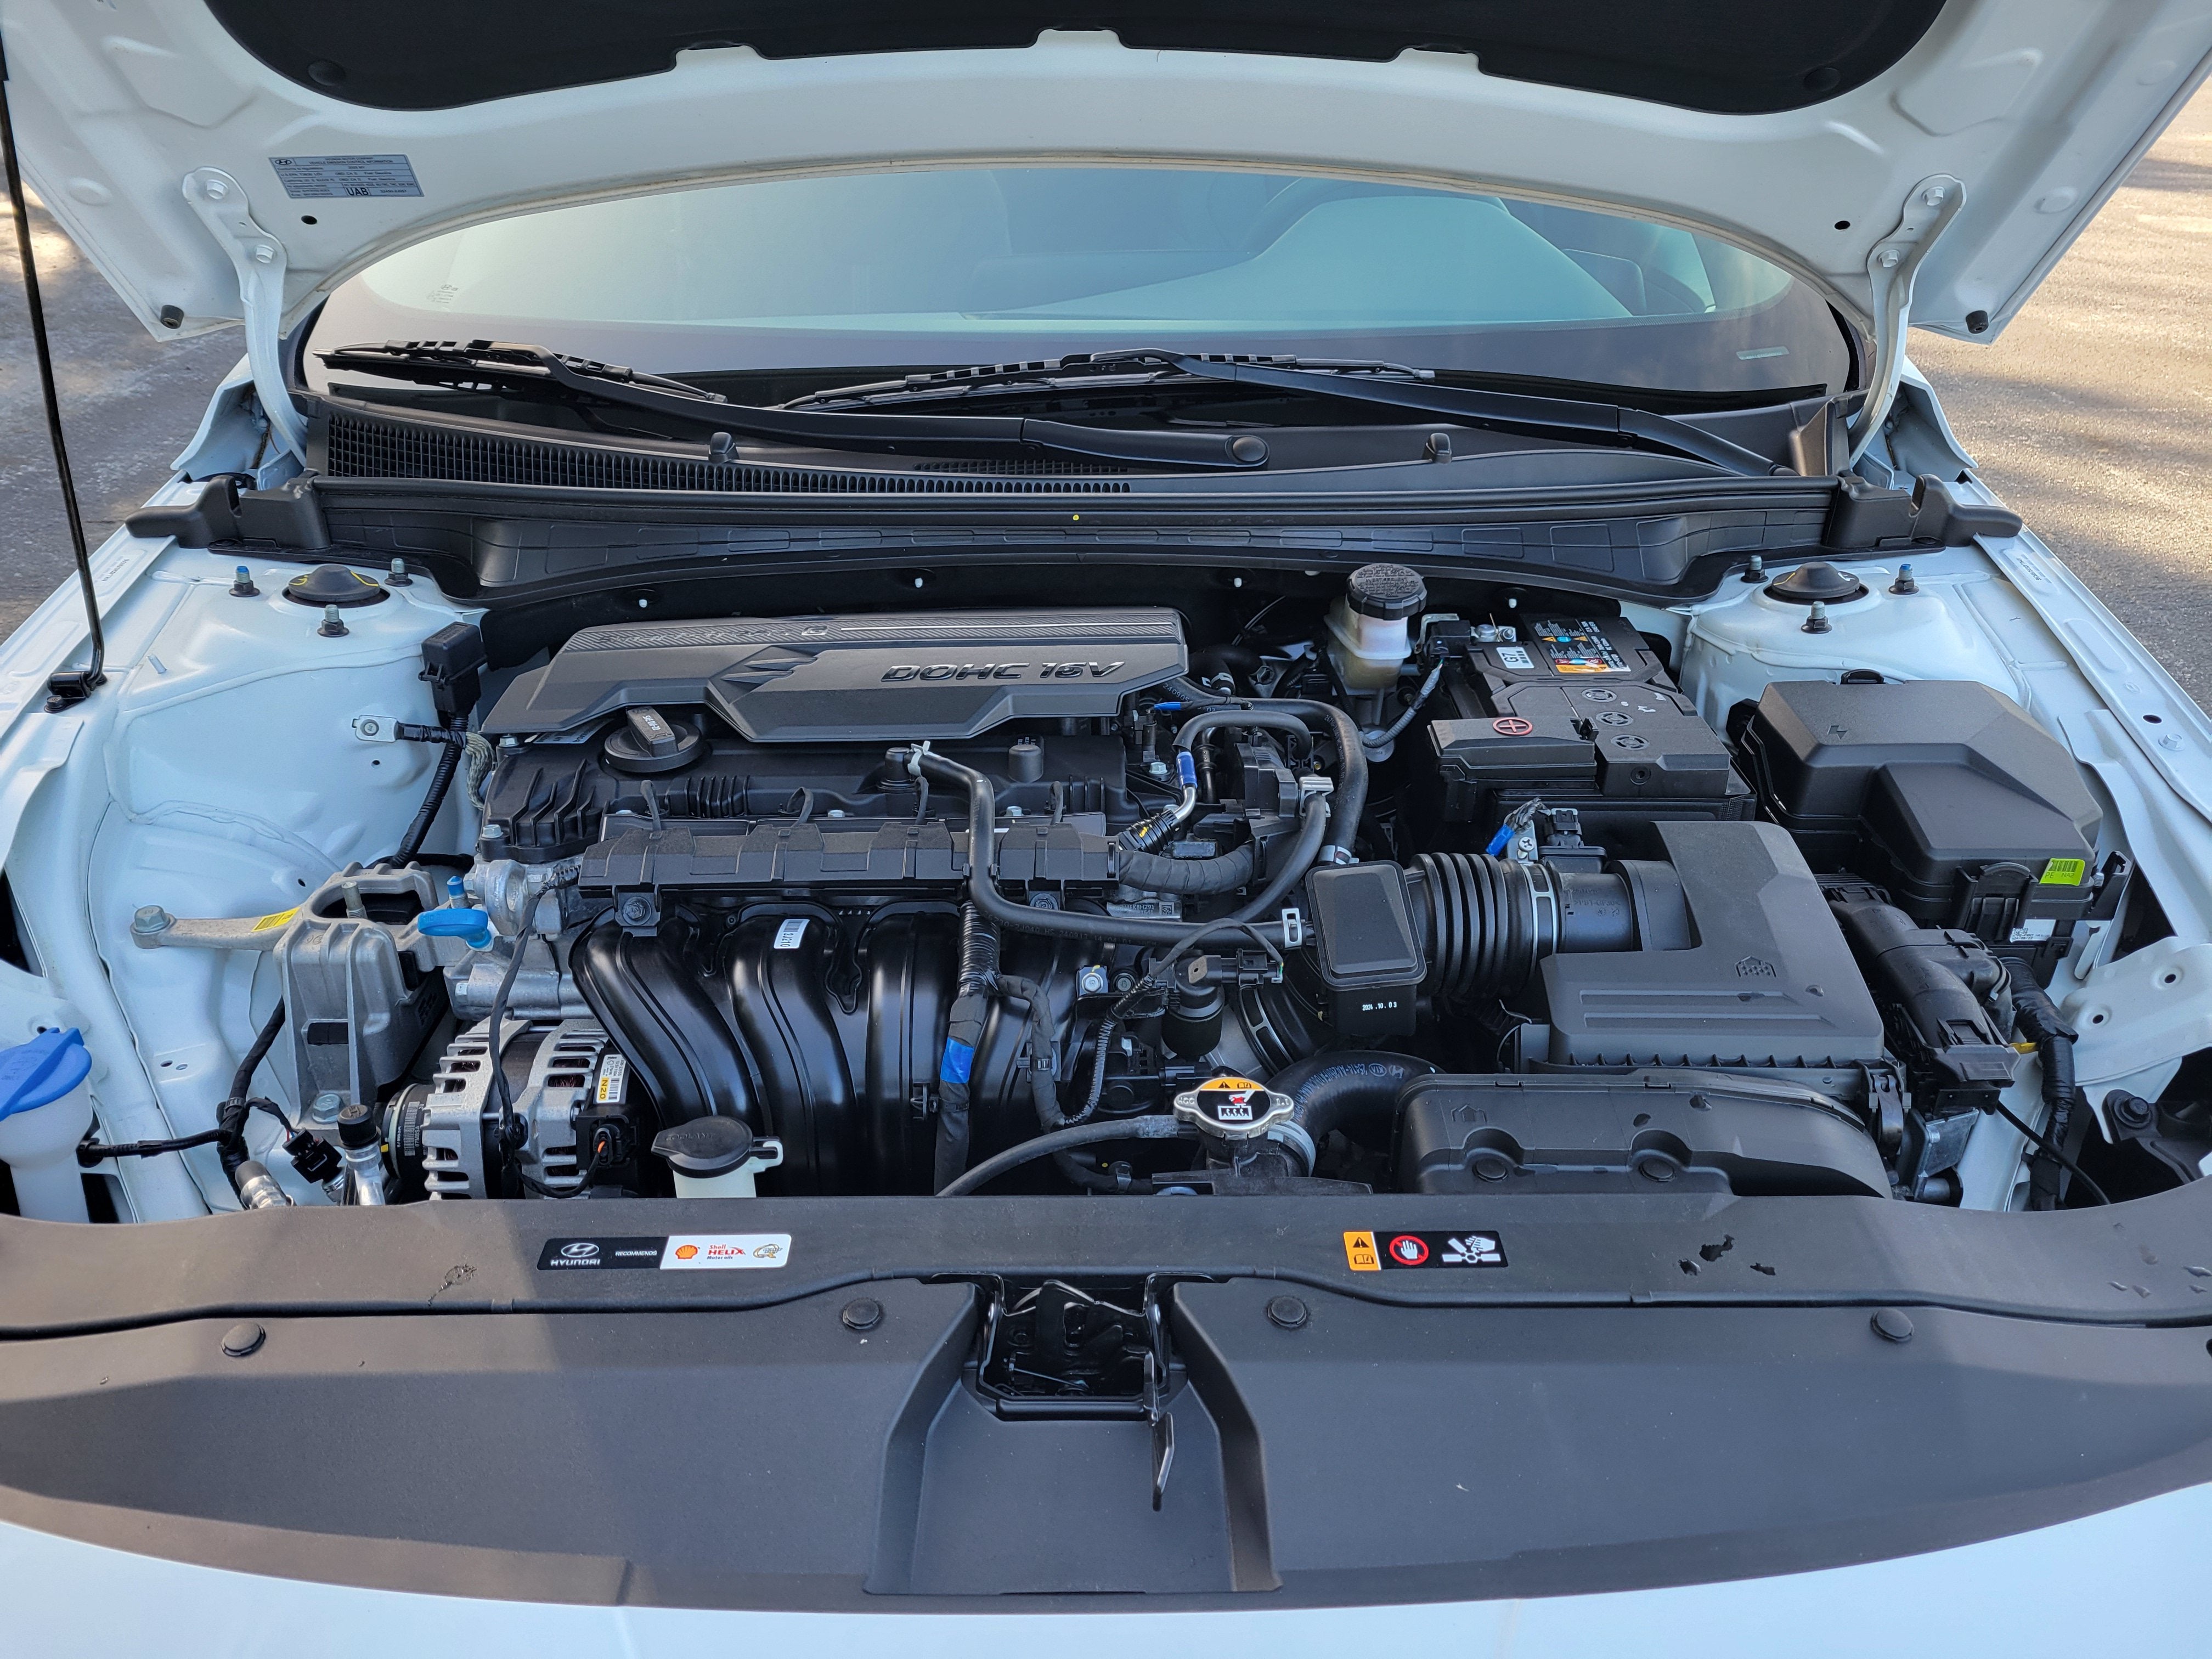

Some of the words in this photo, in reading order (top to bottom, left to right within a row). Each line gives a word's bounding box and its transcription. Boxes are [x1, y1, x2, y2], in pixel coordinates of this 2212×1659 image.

[346, 188, 369, 196] UAB
[1501, 653, 1519, 663] G7
[880, 662, 1030, 682] DOHC
[1039, 661, 1126, 679] 16V
[780, 933, 794, 947] 2J210
[599, 1079, 609, 1099] N20
[708, 1246, 746, 1255] HELIX
